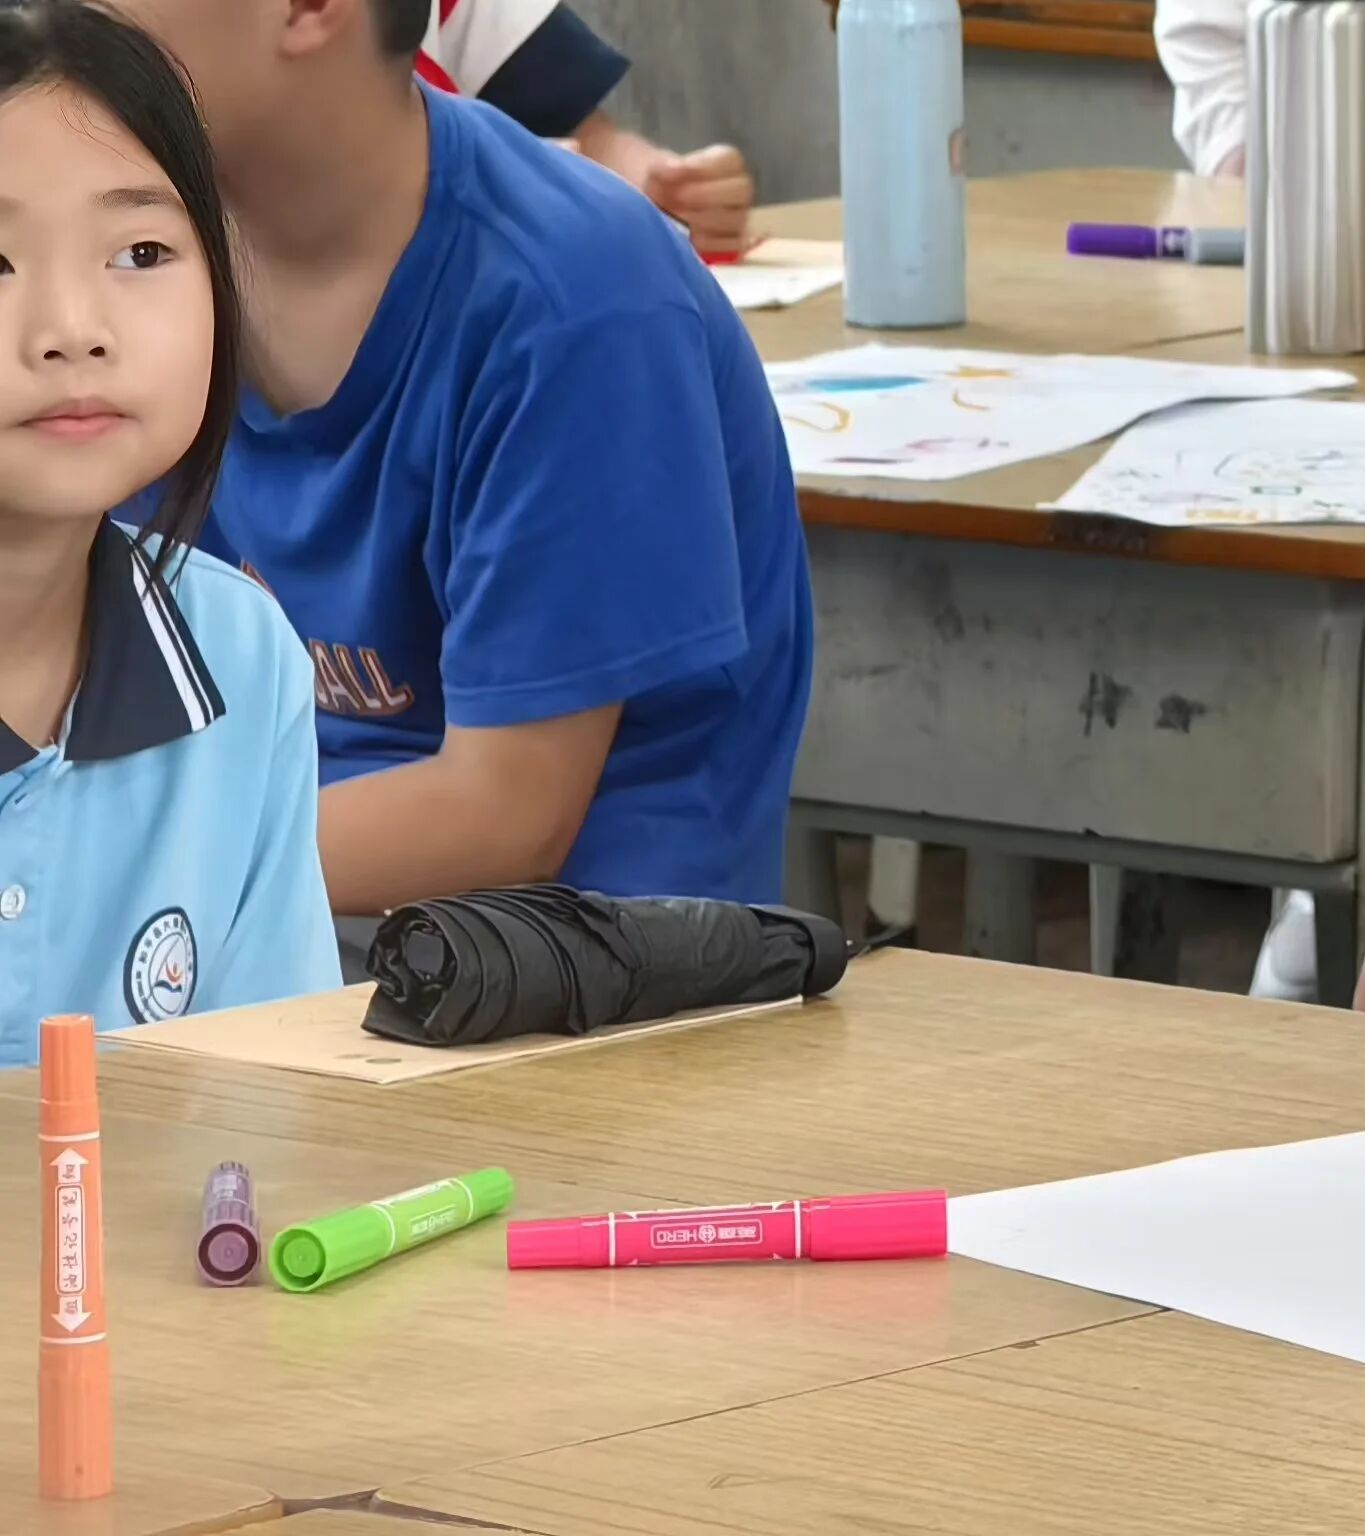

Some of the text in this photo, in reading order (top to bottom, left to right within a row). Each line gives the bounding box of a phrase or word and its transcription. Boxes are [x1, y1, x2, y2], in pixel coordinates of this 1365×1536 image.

[311, 638, 415, 716] ALL
[61, 1190, 79, 1289] 油性记号笔
[656, 1228, 697, 1243] HERO
